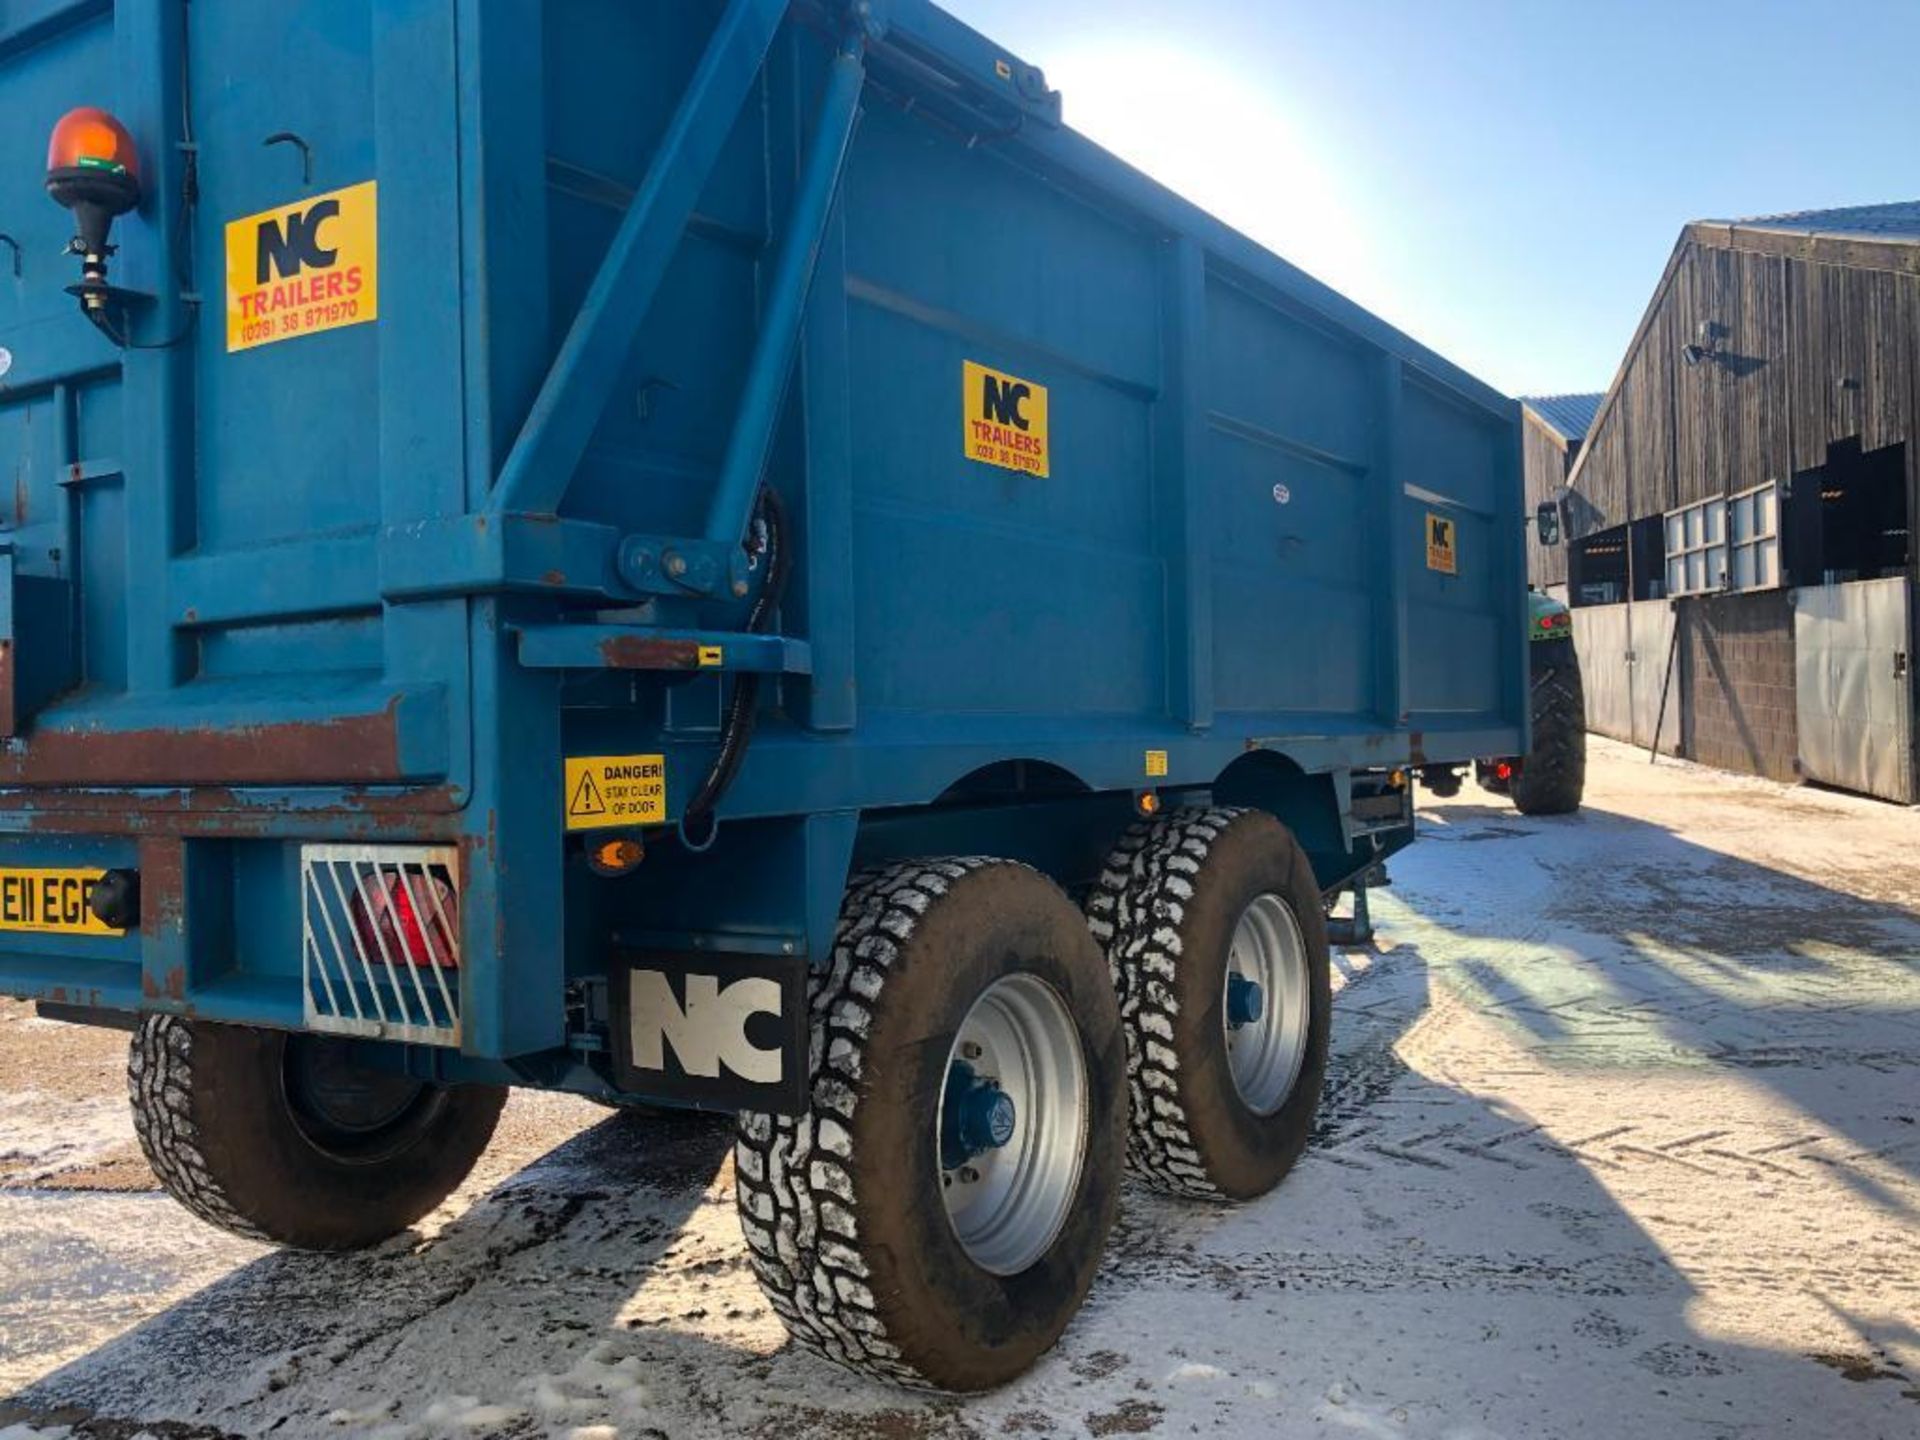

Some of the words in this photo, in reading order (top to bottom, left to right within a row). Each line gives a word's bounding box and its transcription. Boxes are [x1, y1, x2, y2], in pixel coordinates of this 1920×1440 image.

[257, 200, 340, 285] NC
[240, 266, 362, 320] TRAILERS
[984, 374, 1031, 431] NC
[971, 419, 1042, 455] TRAILERS
[1432, 518, 1448, 549] NC
[604, 764, 662, 780] DANGER!
[605, 786, 628, 799] STAY
[631, 784, 662, 797] CLEAR
[614, 803, 626, 815] OF
[628, 801, 655, 814] DOOR
[630, 968, 782, 1083] NC
